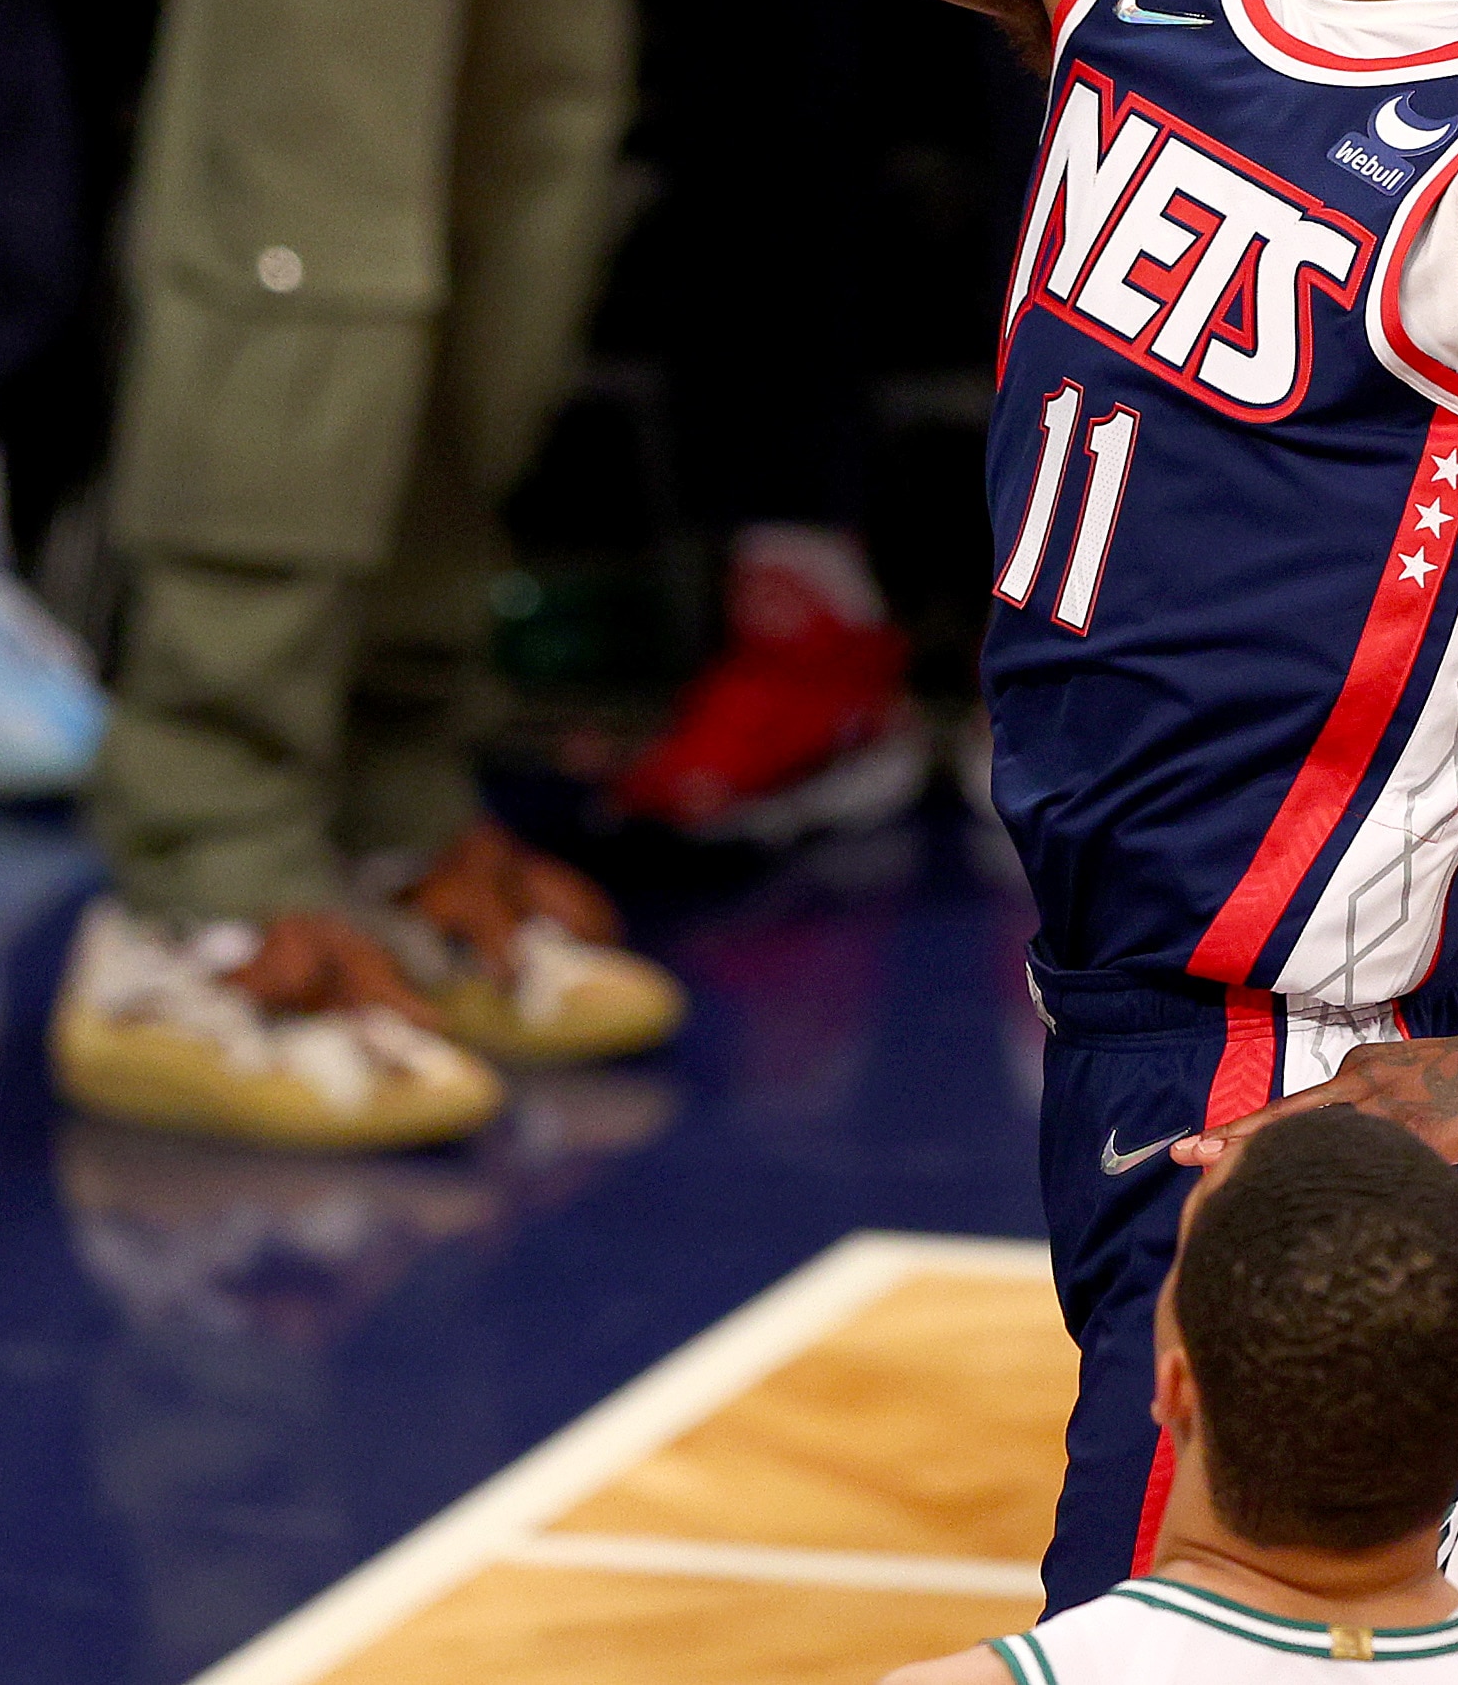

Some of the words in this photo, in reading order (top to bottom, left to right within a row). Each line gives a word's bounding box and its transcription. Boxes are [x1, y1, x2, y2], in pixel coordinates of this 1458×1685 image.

[998, 60, 1377, 423] NETS
[1335, 140, 1405, 191] Webull
[992, 376, 1141, 637] 11
